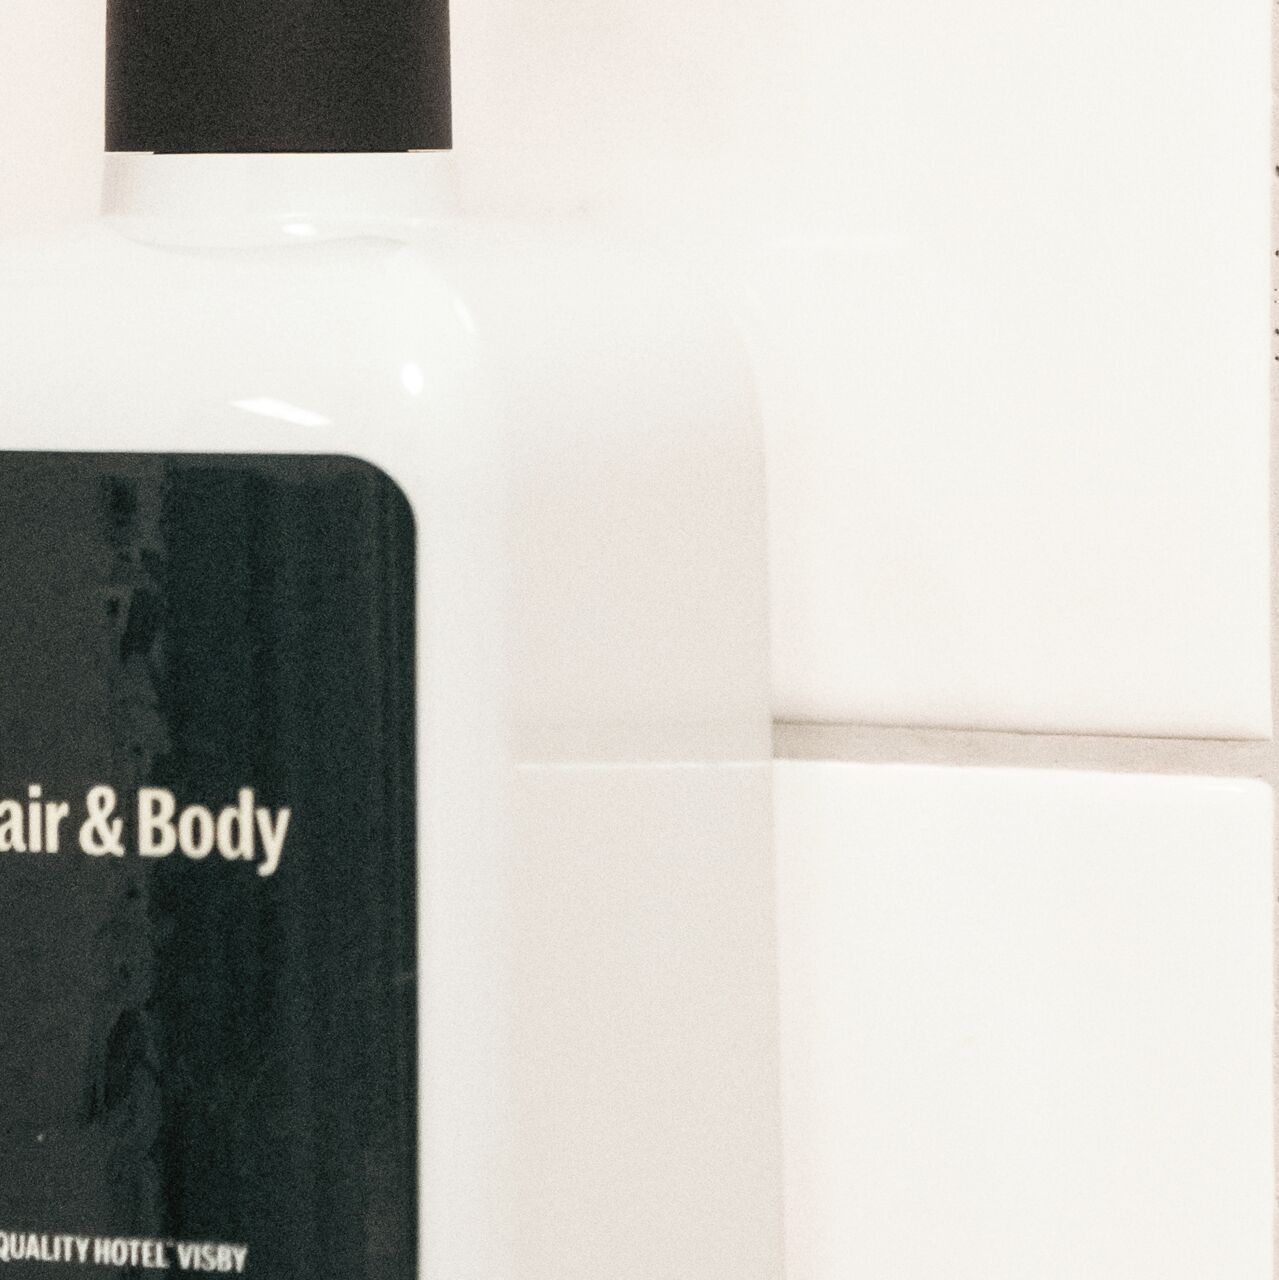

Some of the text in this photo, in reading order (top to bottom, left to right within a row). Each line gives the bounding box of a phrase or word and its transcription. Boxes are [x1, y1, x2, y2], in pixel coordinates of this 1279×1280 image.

[77, 783, 126, 858] &
[136, 786, 291, 877] Body
[176, 1242, 248, 1274] VISBY
